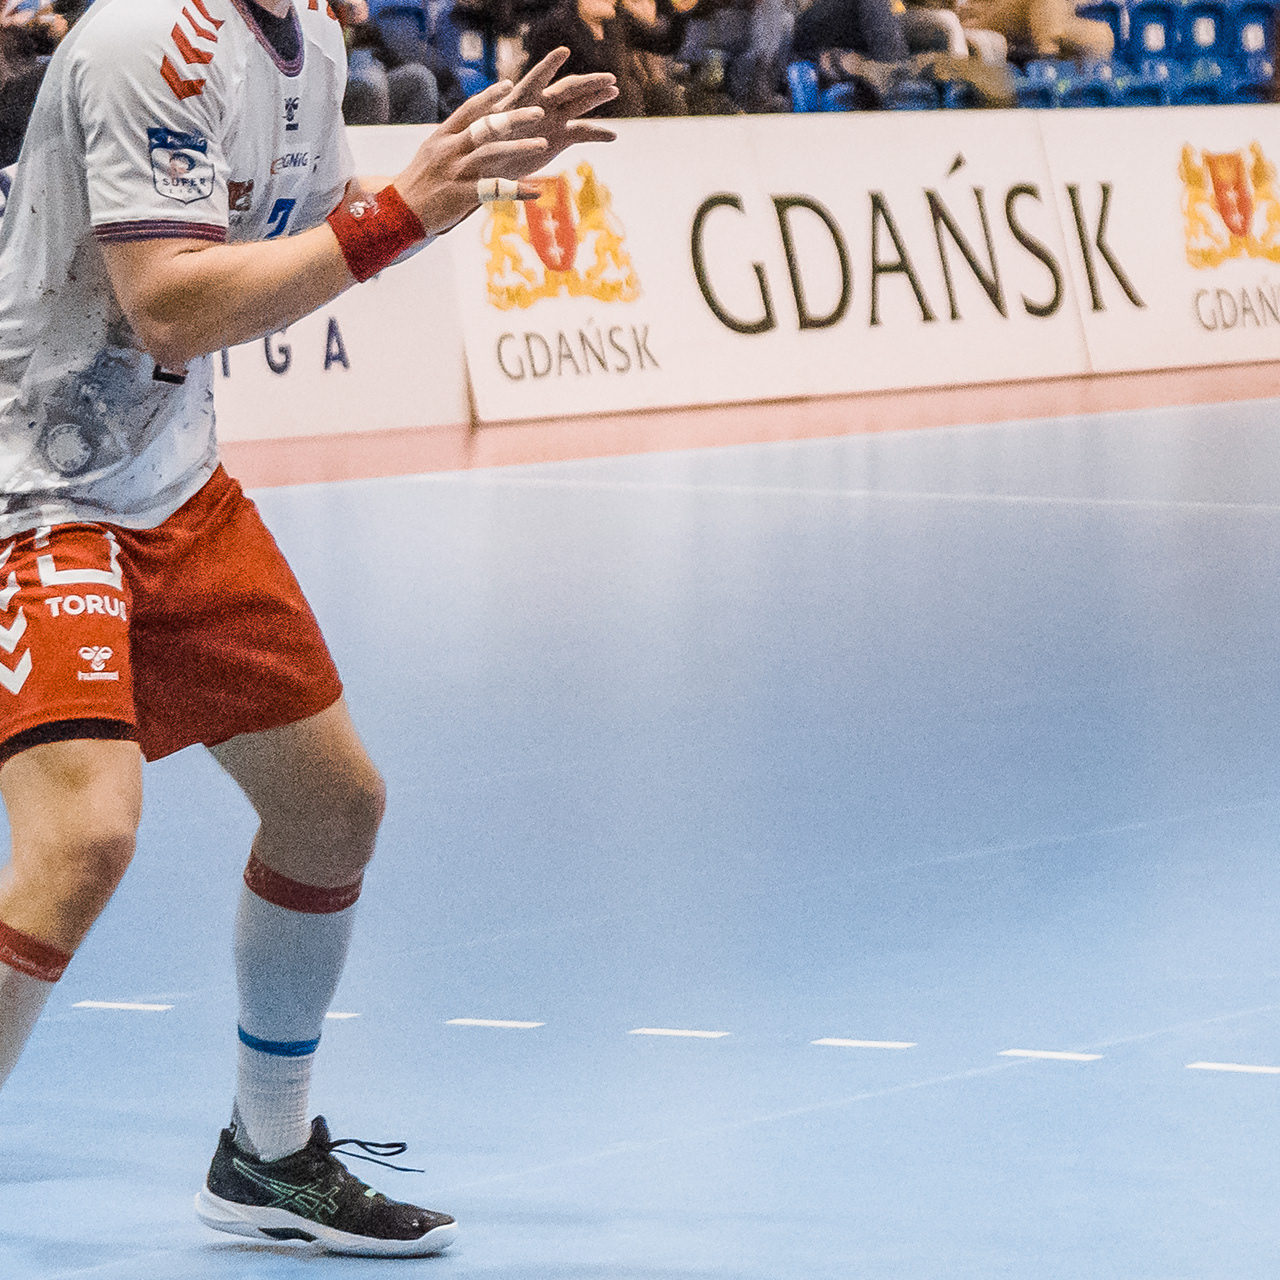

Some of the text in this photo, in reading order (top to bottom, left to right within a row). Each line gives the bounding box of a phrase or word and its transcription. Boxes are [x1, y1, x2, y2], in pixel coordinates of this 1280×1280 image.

[690, 154, 1147, 335] GDAŃSK
[220, 317, 351, 379] IGA
[496, 315, 661, 383] GDAŃSK
